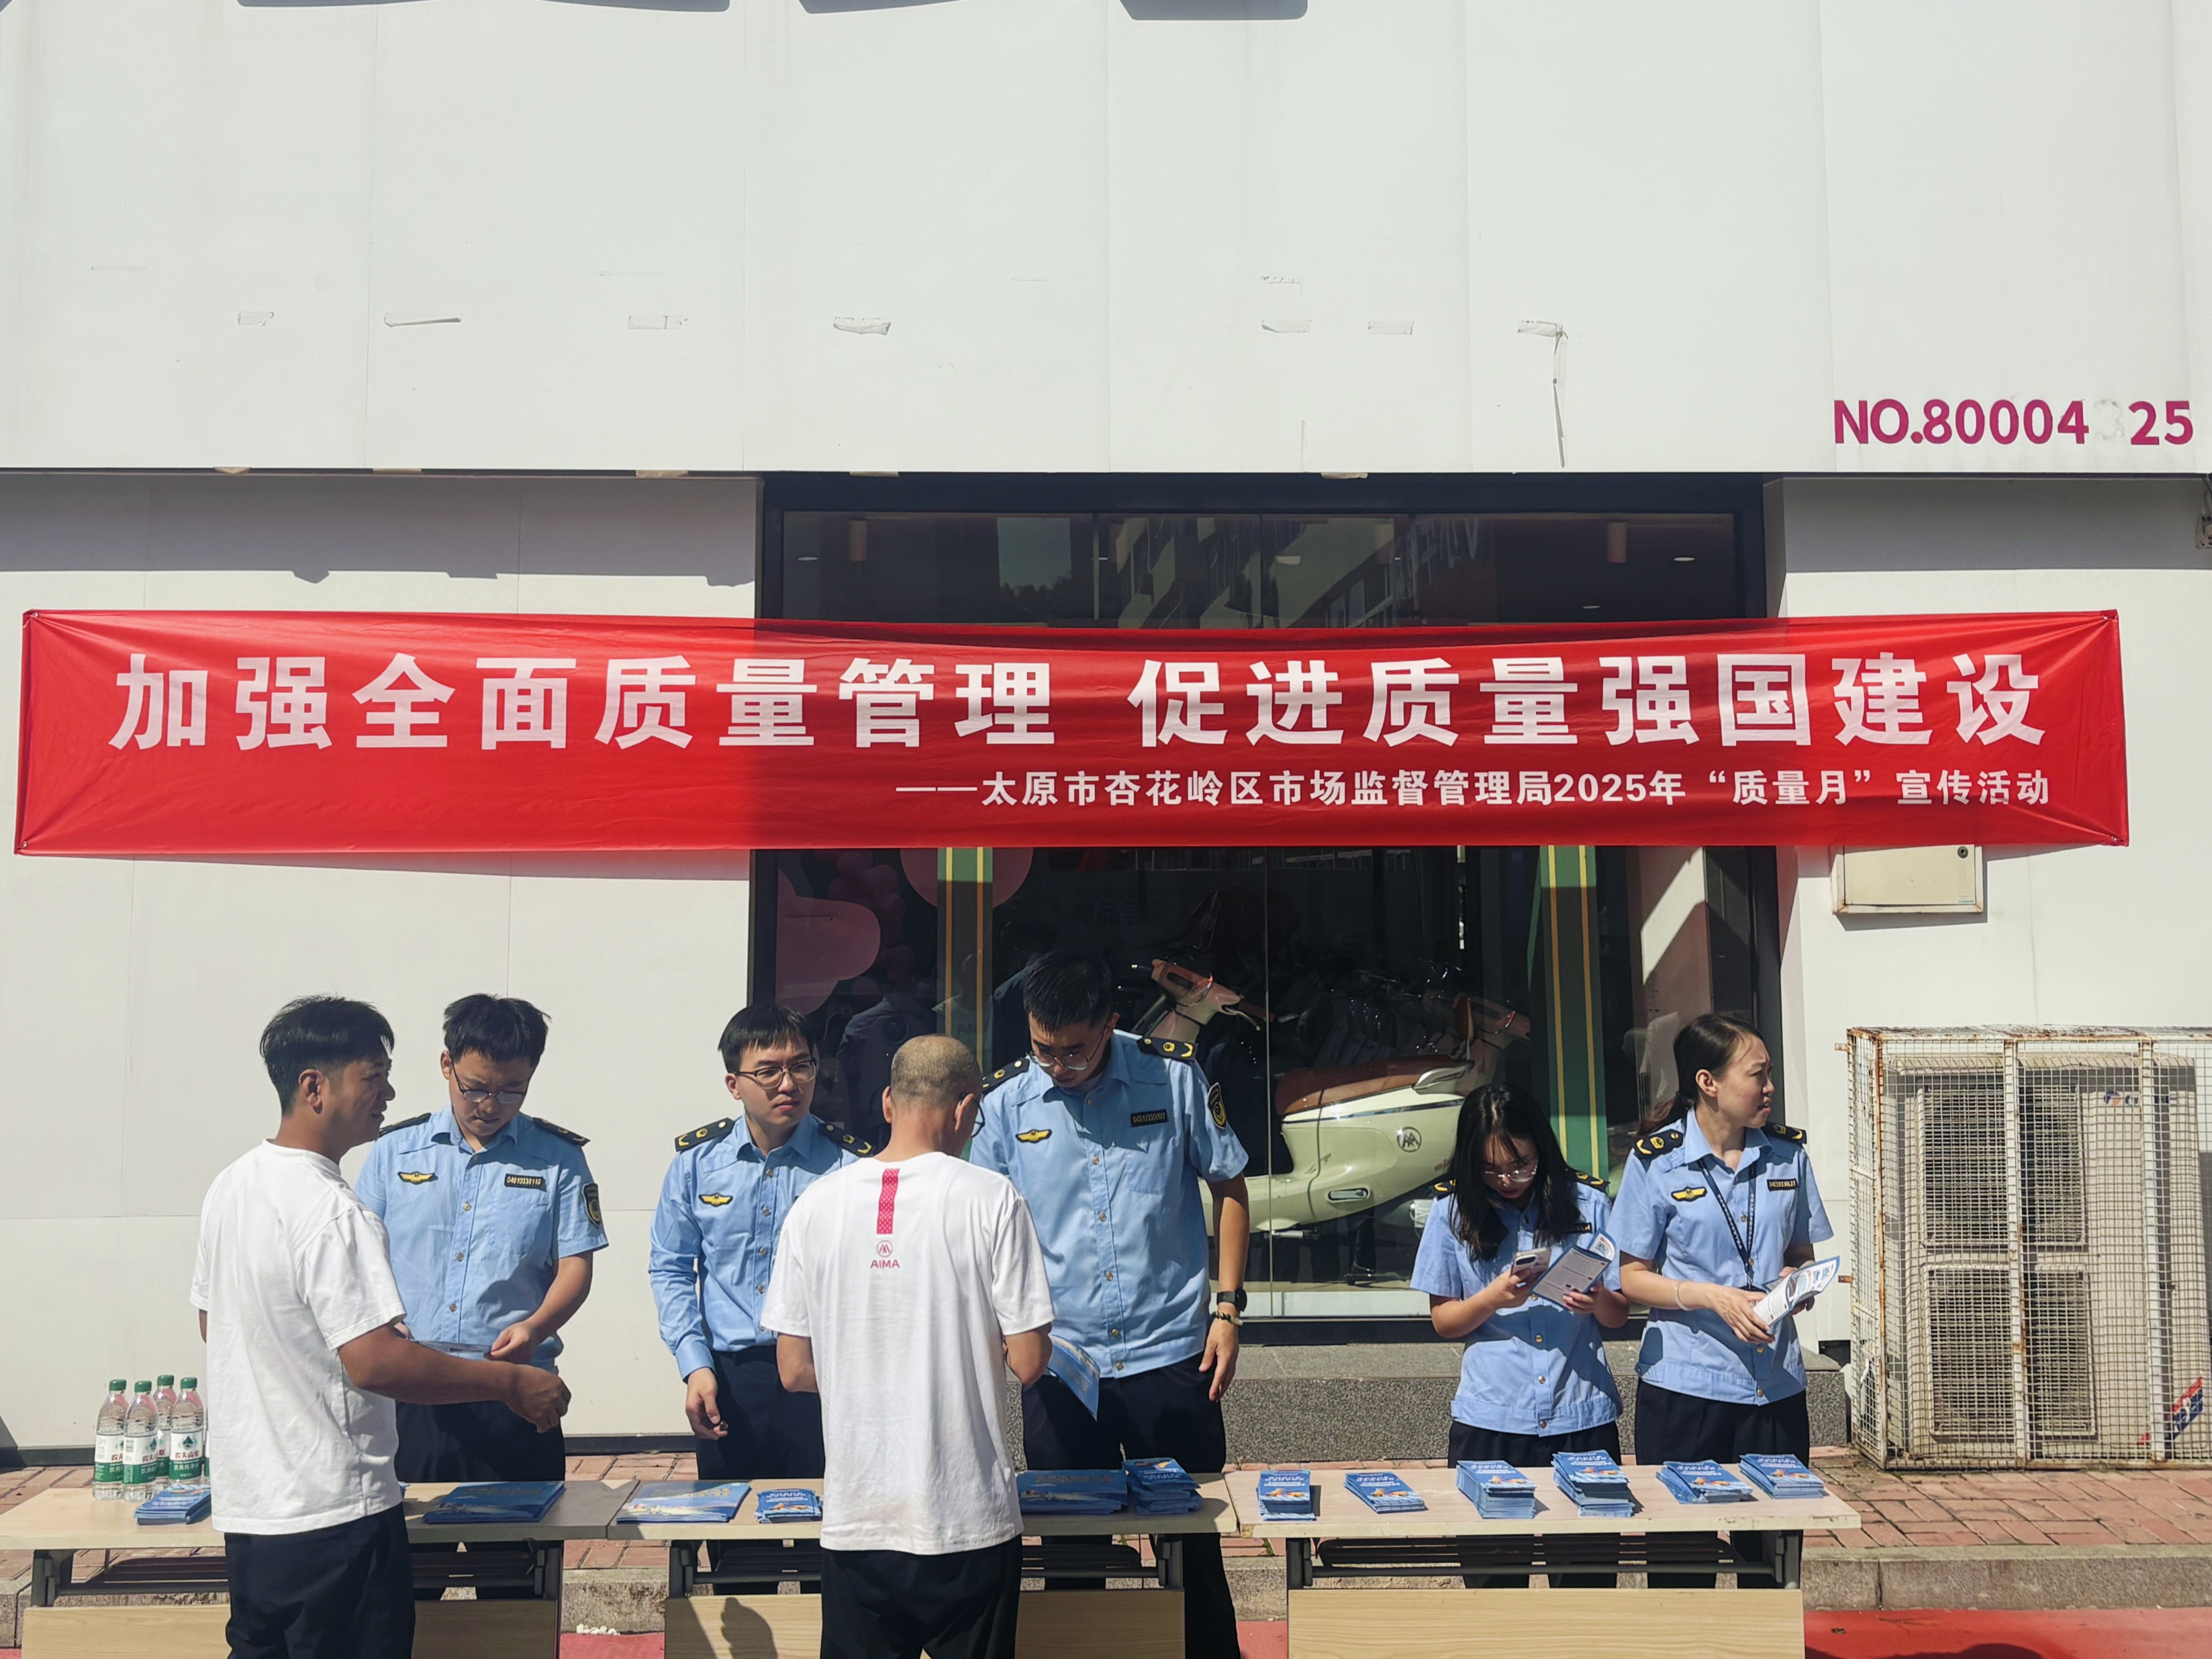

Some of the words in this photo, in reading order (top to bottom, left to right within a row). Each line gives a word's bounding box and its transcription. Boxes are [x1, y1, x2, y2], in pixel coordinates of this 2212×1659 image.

[1834, 399, 2194, 445] NO.8000425
[108, 652, 1055, 751] 加强全面质量管理
[1127, 652, 2046, 747] 促进质量强国建设
[870, 1260, 900, 1269] AIMA
